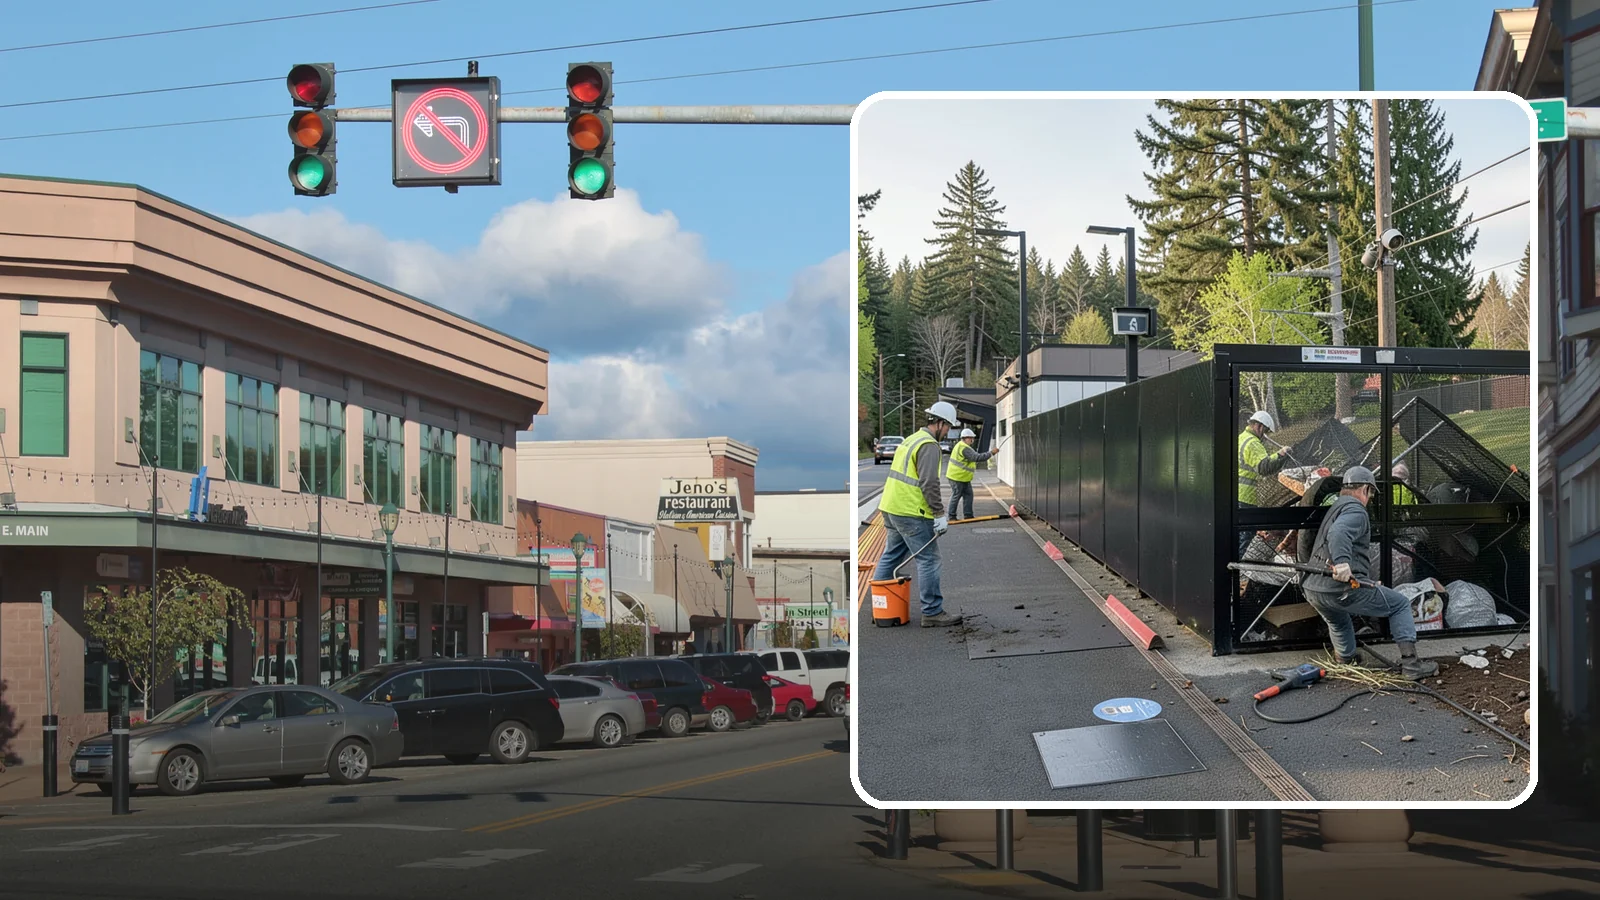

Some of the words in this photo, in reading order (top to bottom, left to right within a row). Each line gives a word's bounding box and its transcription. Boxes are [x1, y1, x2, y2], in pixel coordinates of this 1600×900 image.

[669, 480, 728, 494] Jeno's
[665, 496, 731, 509] restaurant
[658, 509, 681, 520] Italian
[686, 509, 715, 520] American
[715, 509, 738, 519] Cuisine
[2, 525, 13, 536] E.
[15, 525, 49, 536] MAIN
[797, 607, 828, 617] Street
[791, 619, 823, 627] lass
